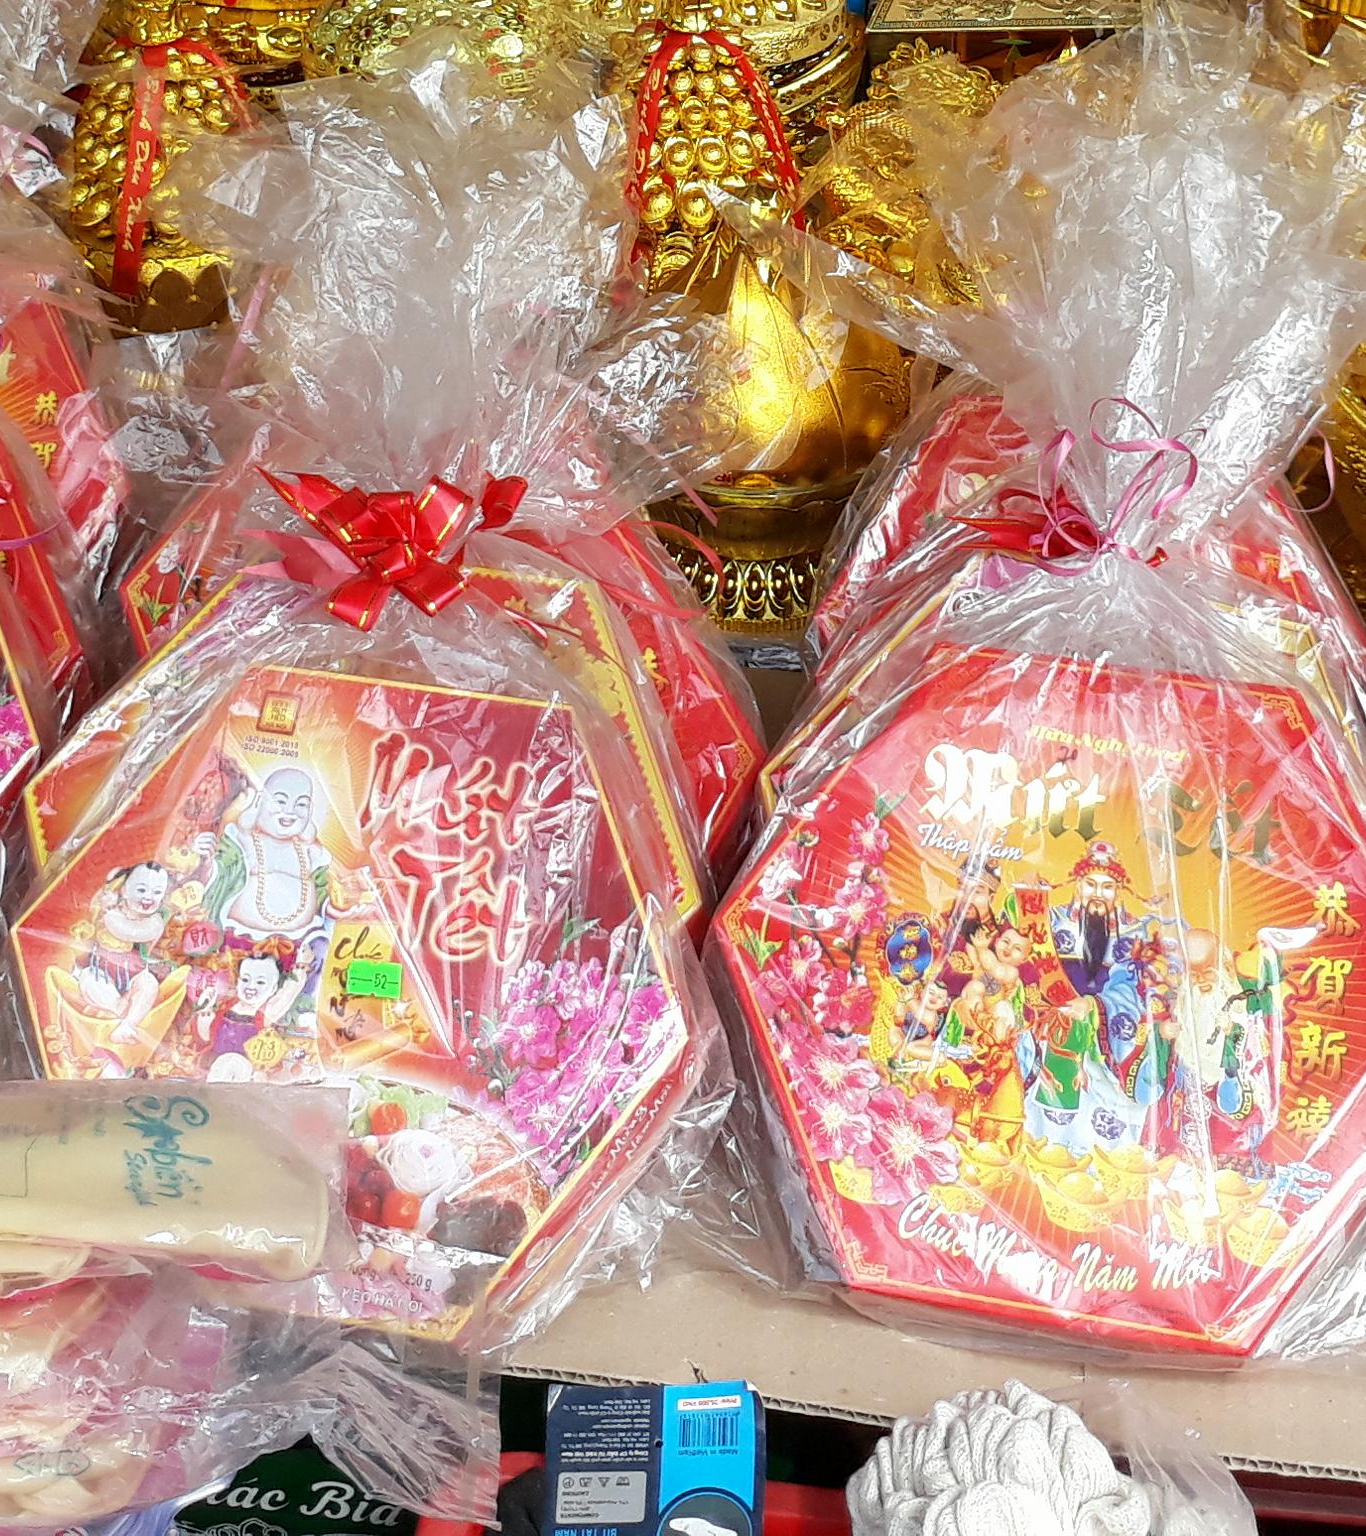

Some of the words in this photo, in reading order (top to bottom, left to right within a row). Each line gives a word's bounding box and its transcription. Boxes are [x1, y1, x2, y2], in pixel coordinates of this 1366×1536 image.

[917, 822, 970, 858] Thập
[389, 847, 529, 965] Tết
[1071, 1240, 1139, 1293] Năm
[716, 1449, 739, 1457] Made
[304, 1479, 406, 1528] Bia
